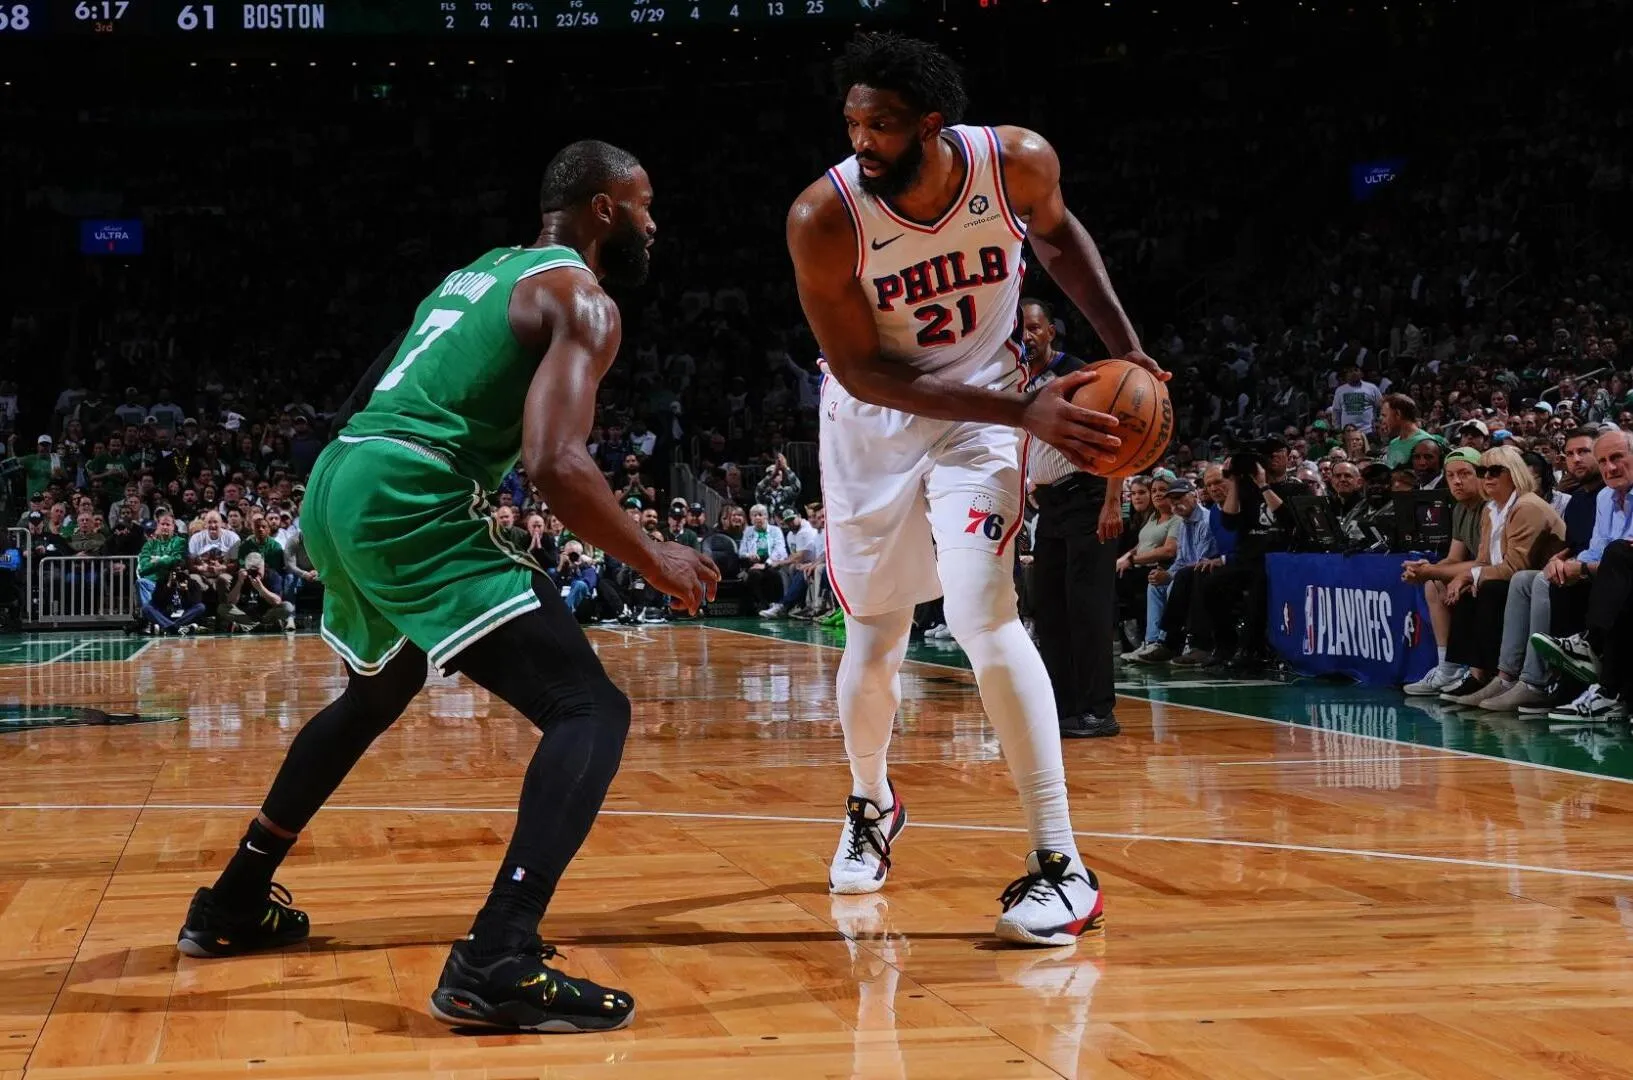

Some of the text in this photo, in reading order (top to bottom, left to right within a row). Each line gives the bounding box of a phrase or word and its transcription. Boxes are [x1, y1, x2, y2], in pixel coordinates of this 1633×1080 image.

[74, 1, 130, 20] 6:17
[177, 4, 325, 30] 61 BOSTON
[440, 0, 584, 11] FLS TOL FG% FG
[445, 0, 825, 29] 2 4 41.1 23/56 9/29 4 4 13 25
[94, 22, 113, 32] 3rd
[94, 231, 129, 240] ULTRA
[963, 213, 1001, 229] crypto.com
[438, 269, 498, 304] BROWN
[873, 245, 1009, 312] PHILA
[913, 294, 977, 347] 21
[374, 308, 464, 391] 7
[964, 508, 1004, 541] 76
[1316, 586, 1394, 663] PLAYOFFS
